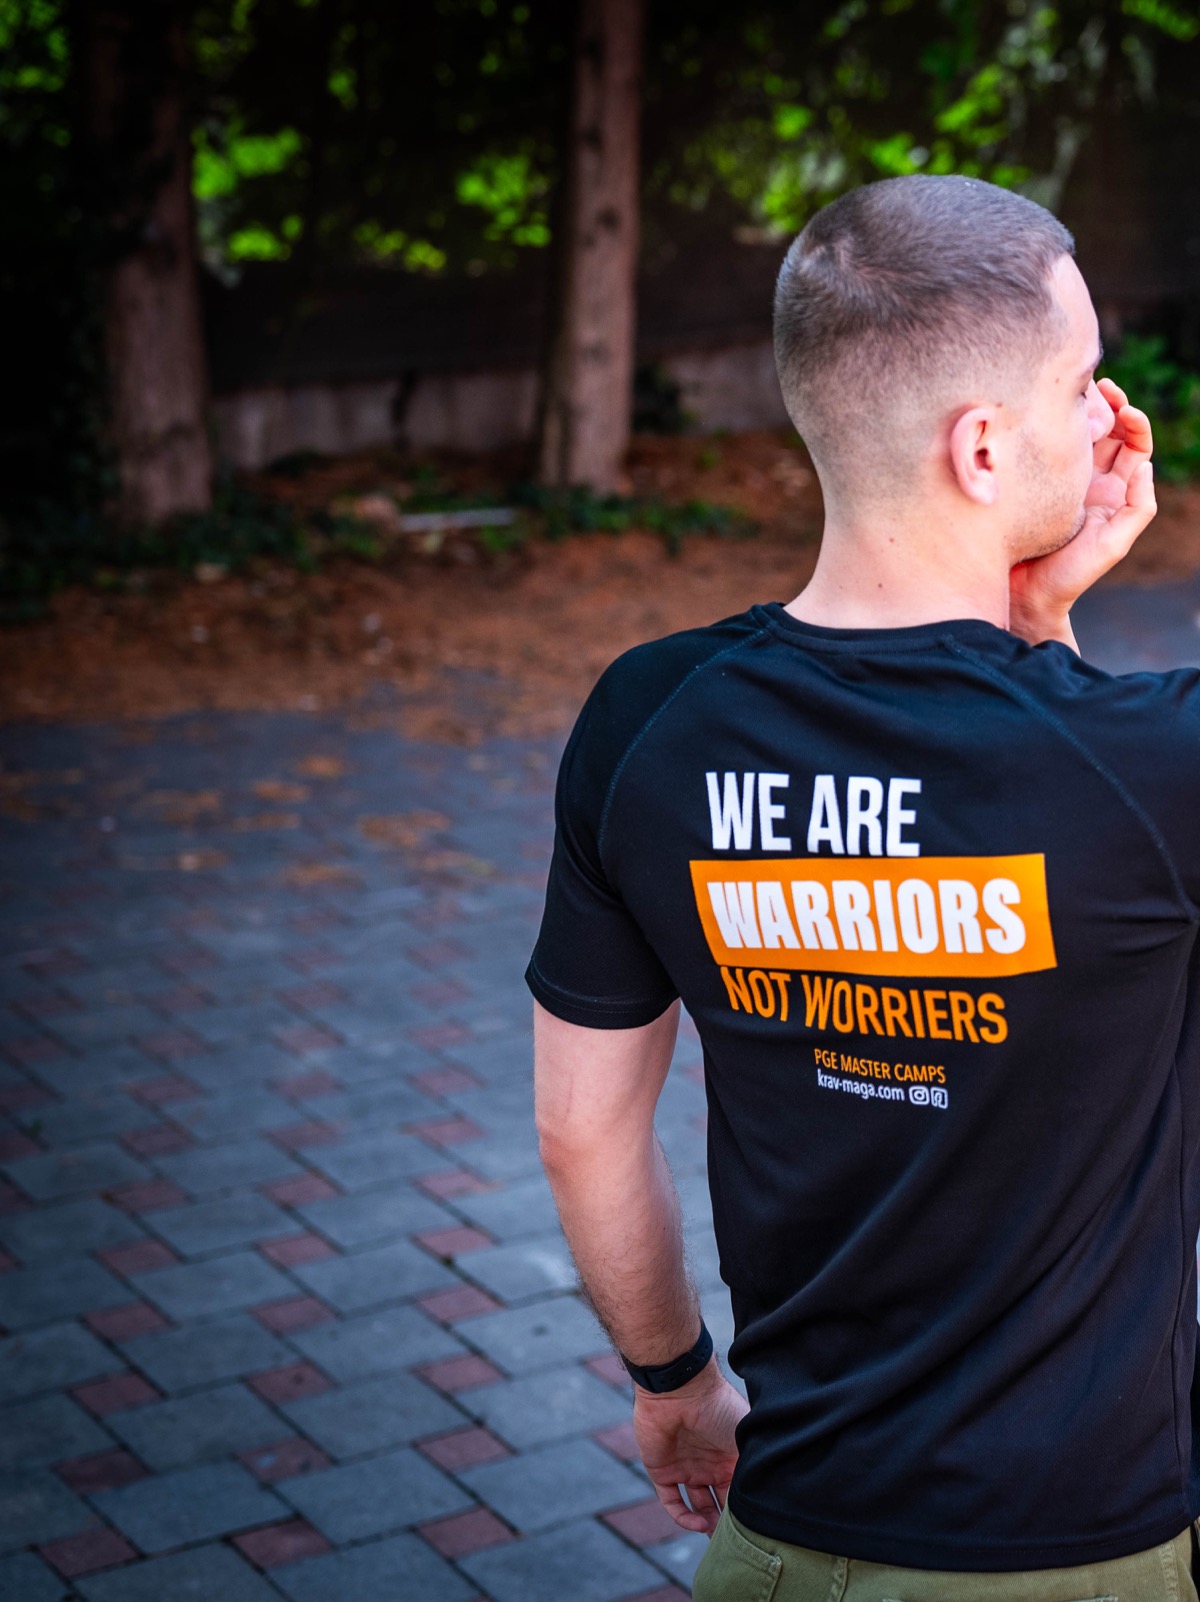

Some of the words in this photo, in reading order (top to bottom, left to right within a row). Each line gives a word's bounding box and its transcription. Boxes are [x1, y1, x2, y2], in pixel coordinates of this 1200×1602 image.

[706, 772, 792, 851] WE
[807, 775, 922, 857] ARE
[707, 878, 1026, 954] WARRIORS
[720, 966, 791, 1022] NOT
[801, 974, 1008, 1044] WORRIERS
[814, 1048, 838, 1070] PGE
[840, 1054, 891, 1080] MASTER
[894, 1063, 946, 1084] CAMPS
[817, 1068, 905, 1100] krav-maga.com
